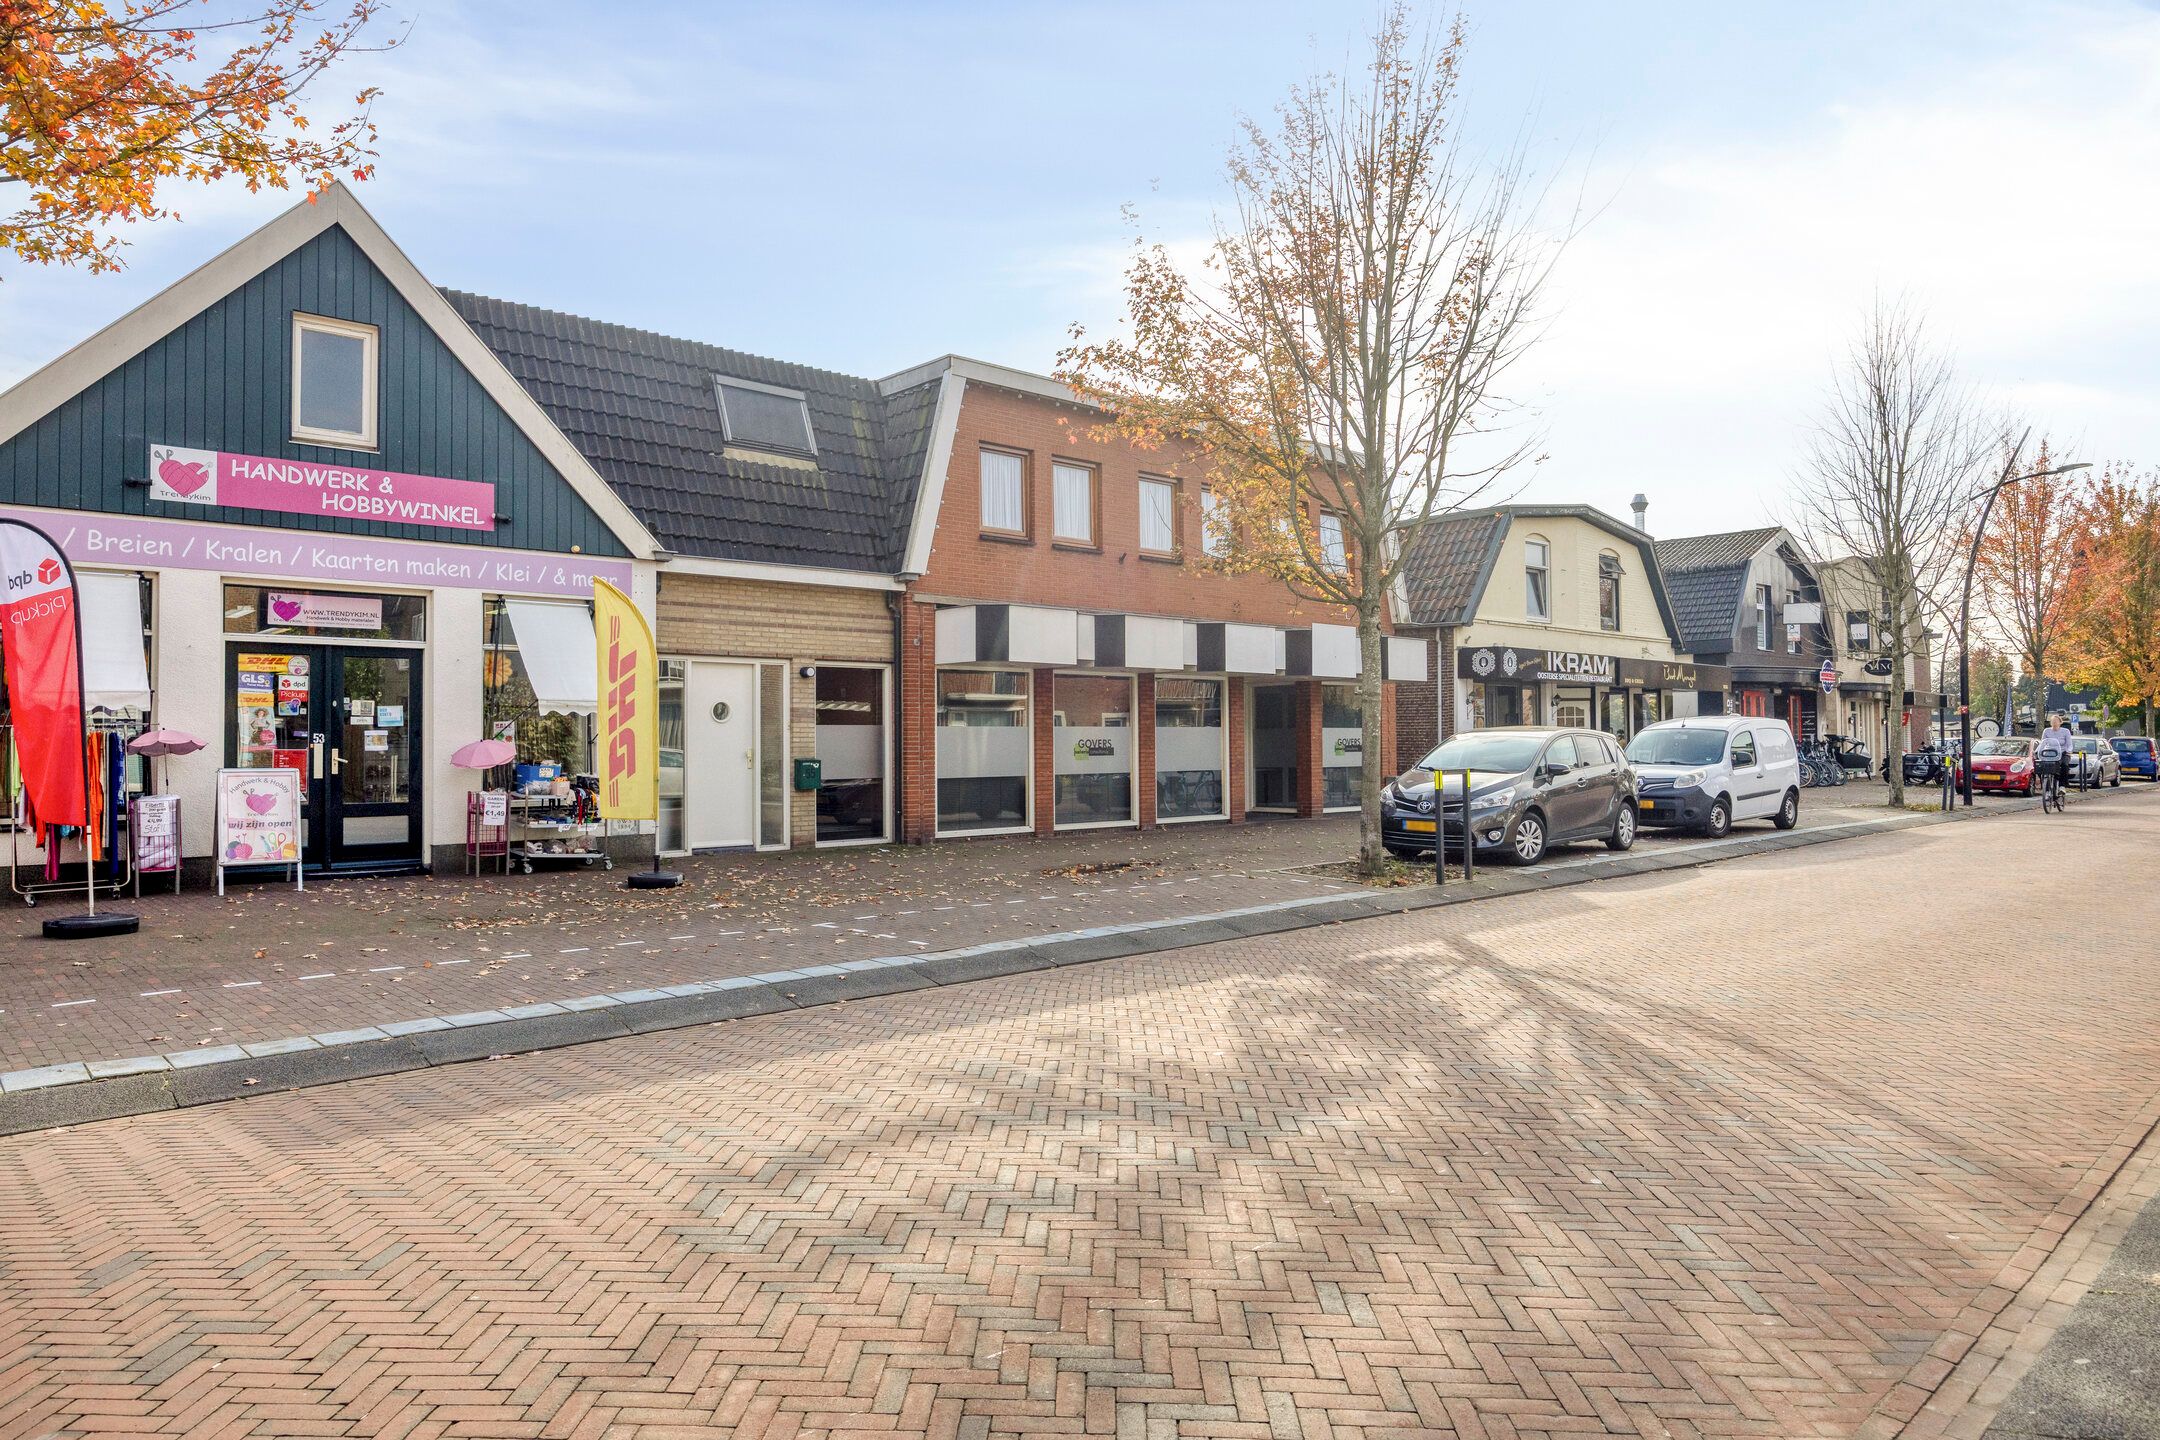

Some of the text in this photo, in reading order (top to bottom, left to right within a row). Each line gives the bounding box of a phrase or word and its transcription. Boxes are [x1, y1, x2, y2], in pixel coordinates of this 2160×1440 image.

[231, 459, 394, 494] HANDWERK &
[321, 492, 485, 525] HOBBYWINKEL
[87, 528, 173, 557] Breien
[205, 539, 282, 565] Kralen
[312, 548, 399, 573] Kaarten
[406, 557, 471, 579] maken
[496, 564, 530, 583] Klei
[553, 568, 566, 586] &
[303, 609, 380, 619] WWW.TRENDYKIM.NL
[247, 657, 287, 665] DHL
[1547, 651, 1610, 675] IKRAM
[241, 673, 265, 684] GLS
[280, 690, 306, 698] Pickup
[313, 733, 325, 744] 53
[1078, 739, 1112, 748] GOVERS
[229, 777, 262, 794] Handwerk
[270, 779, 291, 794] Hobby
[229, 820, 292, 829] wij zijn open
